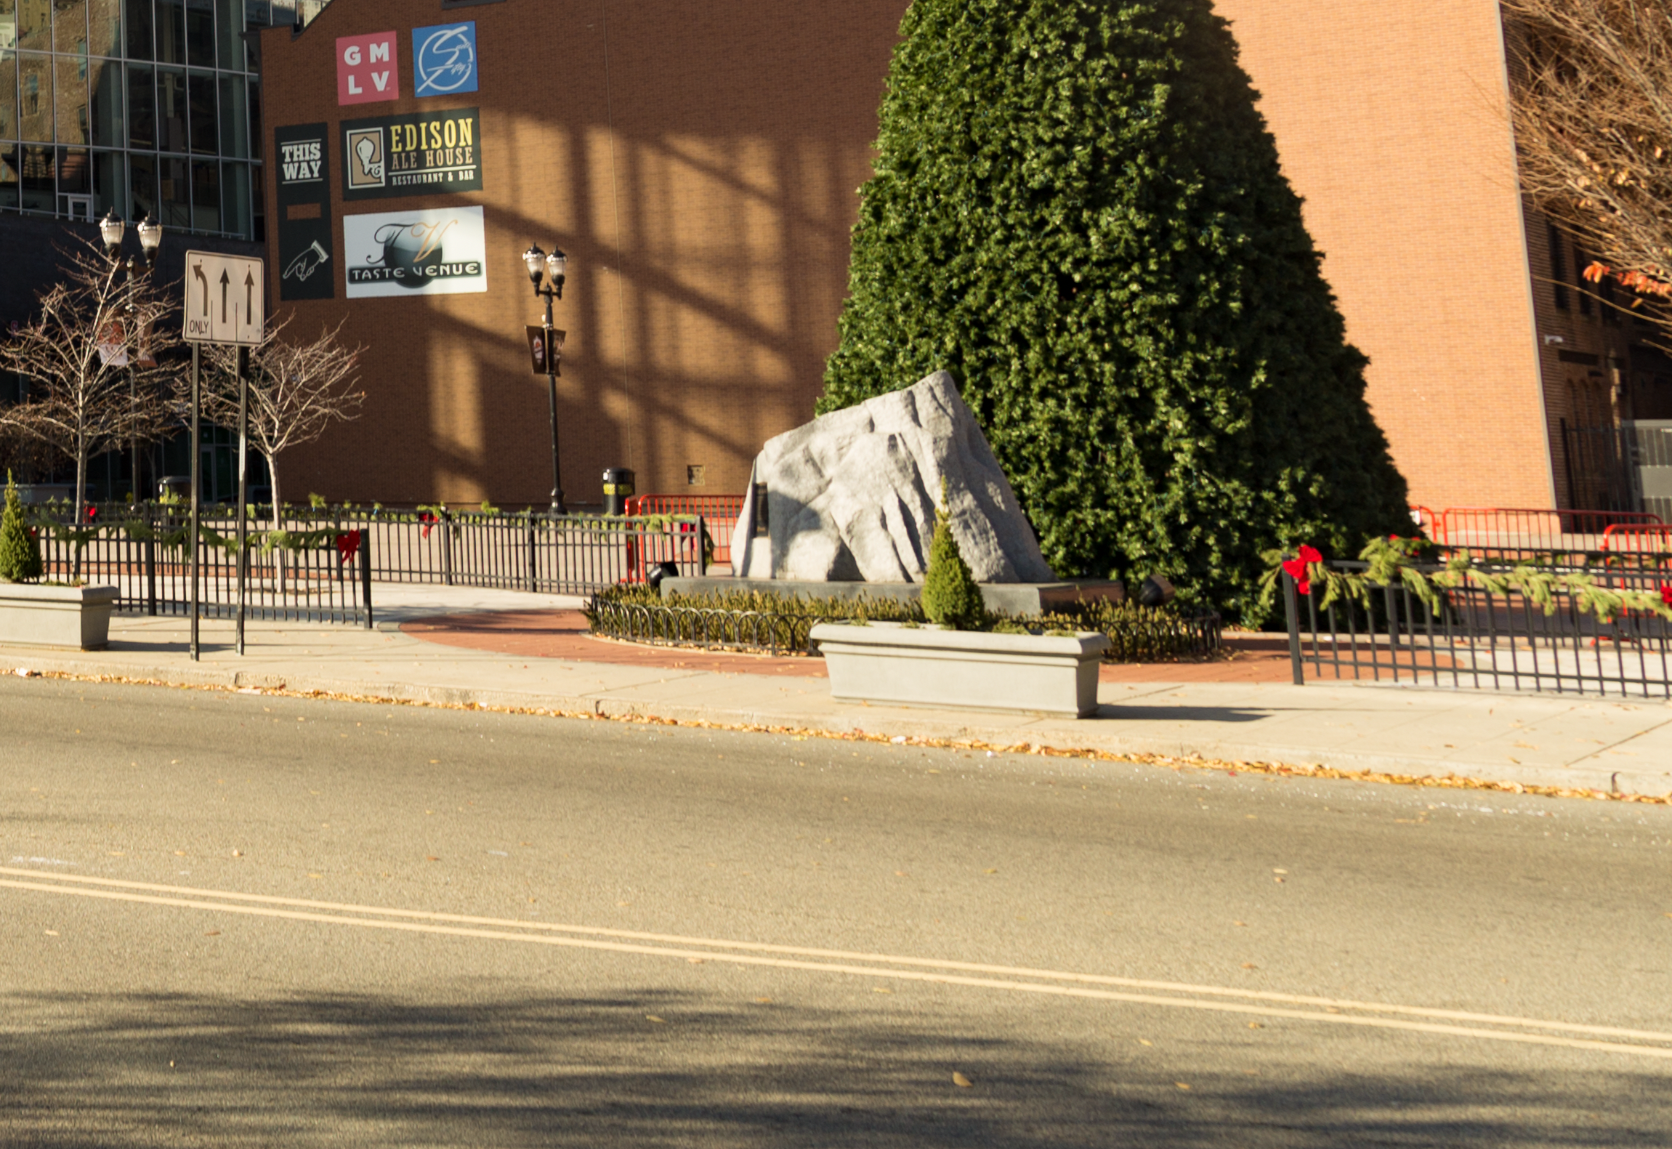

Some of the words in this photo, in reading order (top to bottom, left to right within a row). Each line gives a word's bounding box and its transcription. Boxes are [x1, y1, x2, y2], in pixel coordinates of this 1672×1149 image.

[390, 117, 473, 153] EDISON
[281, 142, 321, 163] THIS
[391, 151, 417, 170] ALE
[425, 146, 473, 167] HOUSE
[282, 160, 322, 181] WAY
[392, 172, 443, 186] RESTAURANT
[447, 171, 453, 182] &
[458, 170, 474, 181] BAR
[352, 267, 405, 281] TASTE
[413, 263, 479, 277] VENUE
[189, 319, 209, 334] ONLY
